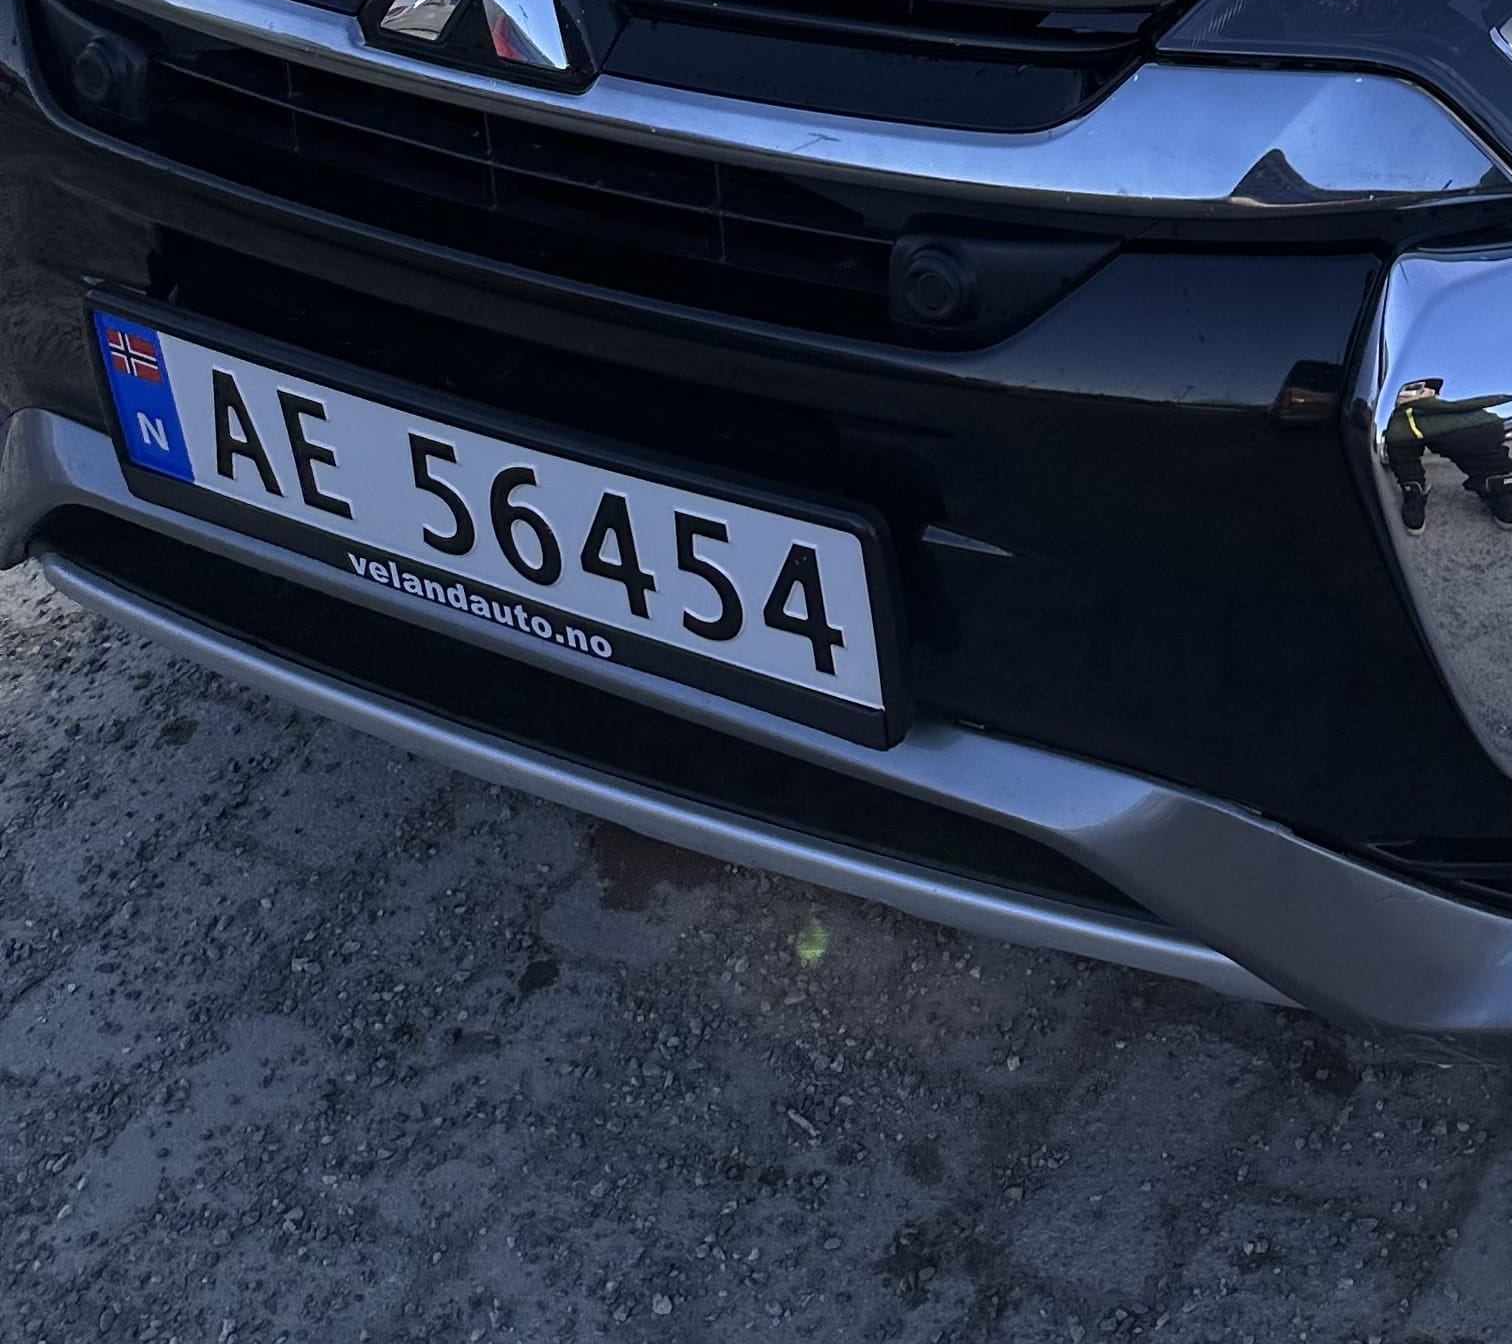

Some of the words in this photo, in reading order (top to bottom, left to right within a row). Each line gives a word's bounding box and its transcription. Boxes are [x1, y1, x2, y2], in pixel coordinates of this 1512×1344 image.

[137, 410, 171, 452] N
[212, 368, 354, 520] AE
[408, 432, 846, 676] 56454
[348, 549, 613, 659] velandauto.no
